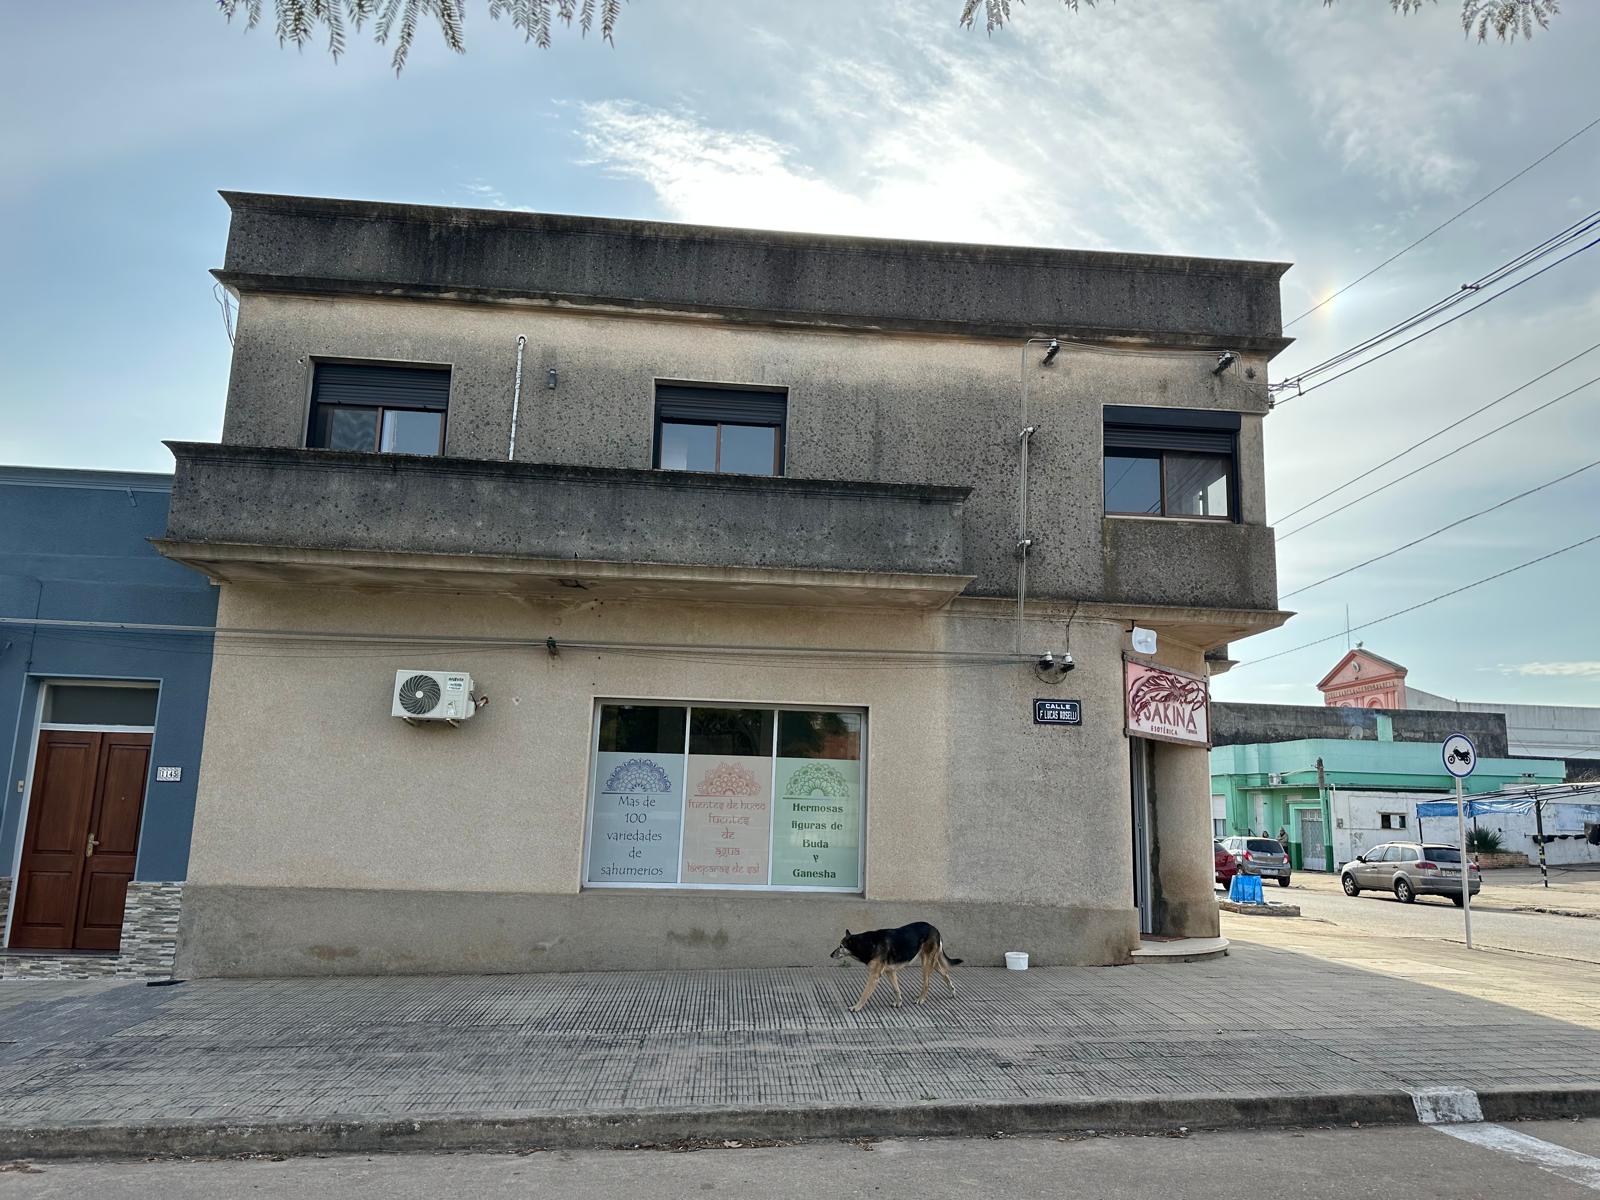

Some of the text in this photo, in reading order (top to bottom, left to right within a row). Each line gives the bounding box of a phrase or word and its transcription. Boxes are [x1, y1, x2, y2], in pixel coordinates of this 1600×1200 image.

[1044, 710, 1059, 720] LUCAS
[1059, 710, 1077, 720] ROSELLI
[1143, 701, 1197, 730] SAKINA
[618, 795, 656, 808] Mas de
[726, 798, 739, 810] de
[792, 803, 844, 813] Hermosas
[625, 813, 647, 824] 100
[791, 820, 843, 831] figuras de
[607, 829, 663, 842] variedades
[721, 826, 736, 839] de
[802, 839, 829, 849] Buda
[628, 846, 642, 859] de
[714, 847, 741, 858] agua
[812, 853, 819, 863] y
[600, 862, 664, 877] sahumerios
[731, 862, 745, 873] de
[792, 868, 837, 879] Ganesha
